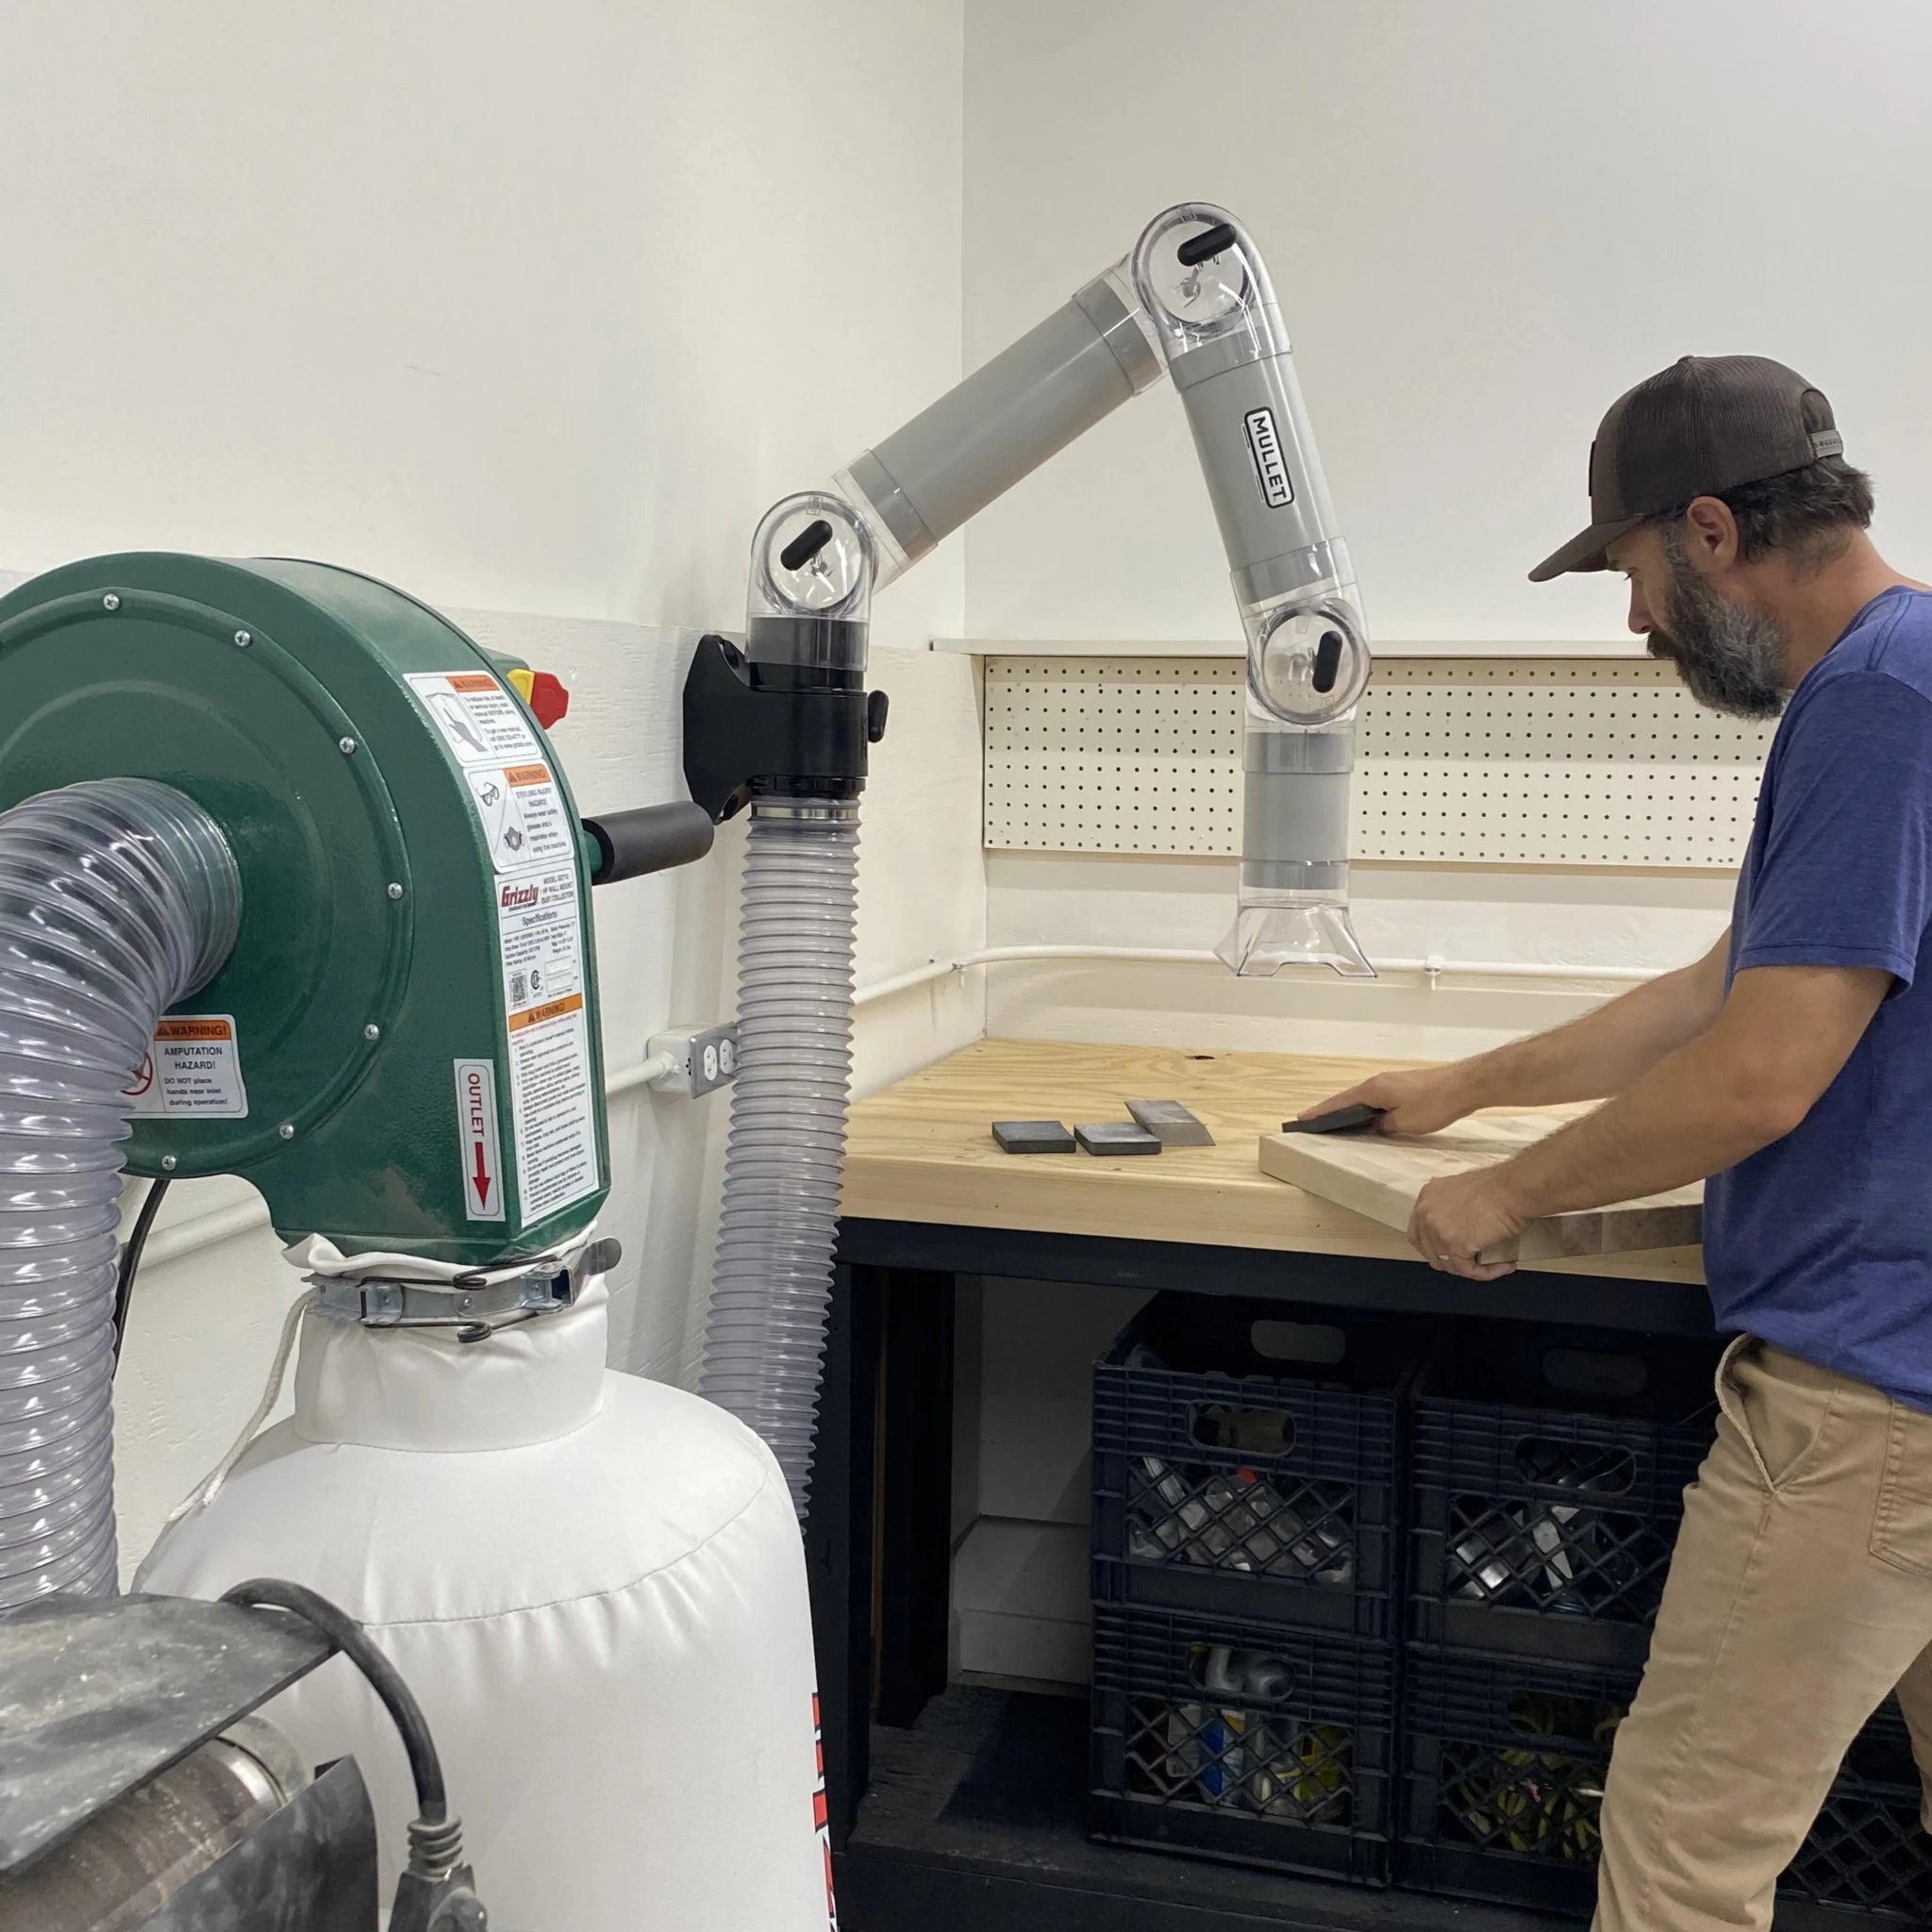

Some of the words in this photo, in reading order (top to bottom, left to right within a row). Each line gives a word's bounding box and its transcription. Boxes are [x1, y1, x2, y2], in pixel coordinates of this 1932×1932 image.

[1253, 416, 1287, 498] MULLET
[501, 884, 539, 908] Grizzly
[522, 911, 558, 926] Specifications
[170, 1025, 226, 1036] WARNING!
[164, 1046, 223, 1056] AMPUTATION
[175, 1061, 216, 1070] HAZARD!
[468, 1074, 485, 1137] OUTLET
